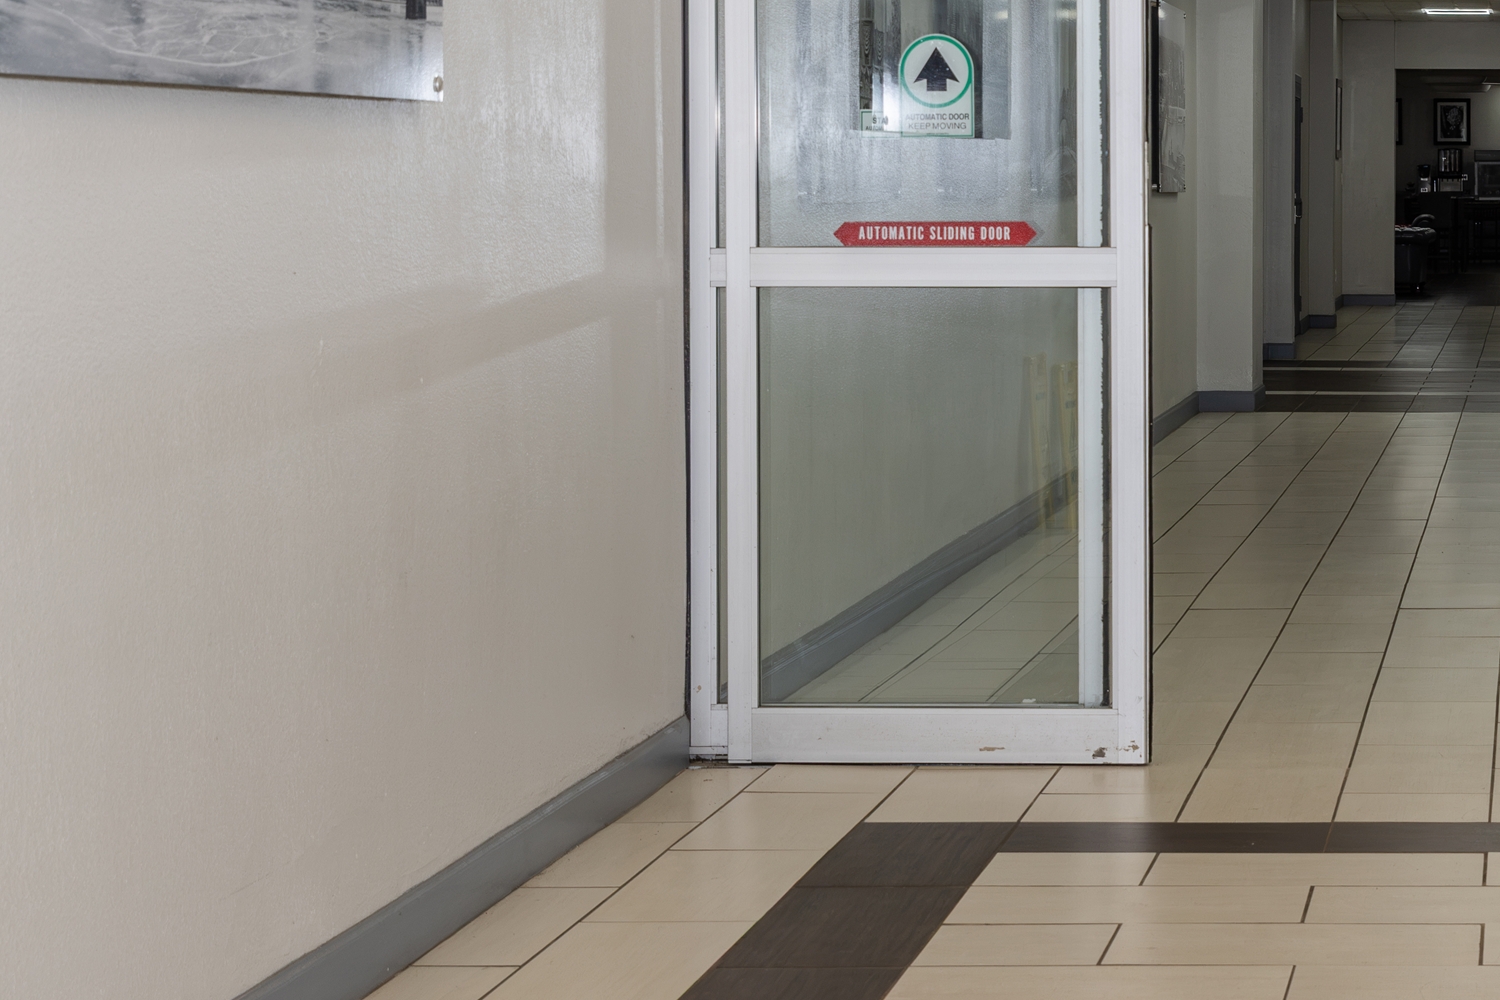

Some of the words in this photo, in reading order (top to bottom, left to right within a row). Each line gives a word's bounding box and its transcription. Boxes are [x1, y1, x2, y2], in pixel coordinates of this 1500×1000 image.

[932, 122, 967, 130] MOVING
[858, 226, 924, 240] AUTOMATIC
[929, 226, 975, 240] SLIDING
[980, 226, 1011, 240] DOOR
